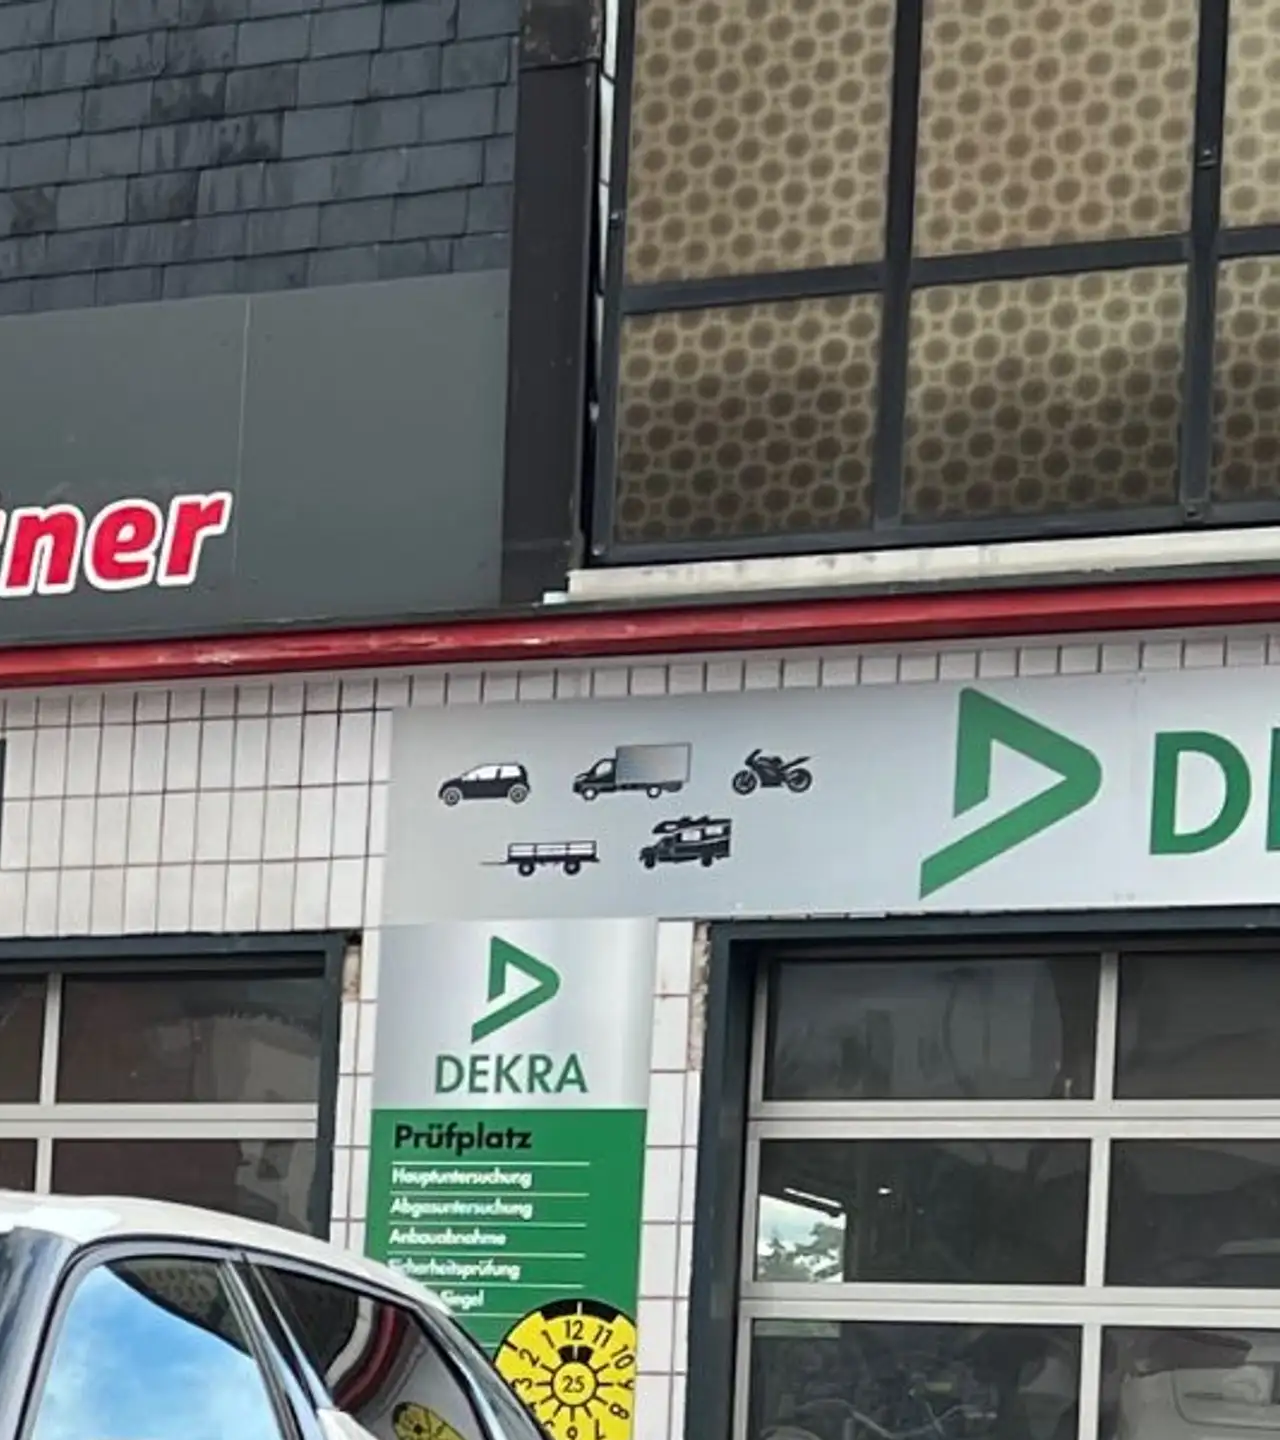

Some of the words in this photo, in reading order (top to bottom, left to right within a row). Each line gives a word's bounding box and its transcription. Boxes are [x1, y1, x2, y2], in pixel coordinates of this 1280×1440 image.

[1149, 729, 1280, 856] D
[434, 1053, 589, 1094] DEKRA
[394, 1122, 533, 1157] Prüfplatz
[391, 1166, 533, 1189] Hauptuntersuchung
[390, 1198, 533, 1220] Abgasuntersuchung
[389, 1228, 507, 1246] Anbauabnahme
[541, 1329, 555, 1349] 1
[564, 1319, 584, 1341] 12
[592, 1325, 613, 1348] 11
[519, 1348, 540, 1367] 2
[611, 1344, 635, 1370] 10
[511, 1378, 533, 1390] 3
[562, 1375, 586, 1393] 25
[608, 1402, 630, 1420] 8
